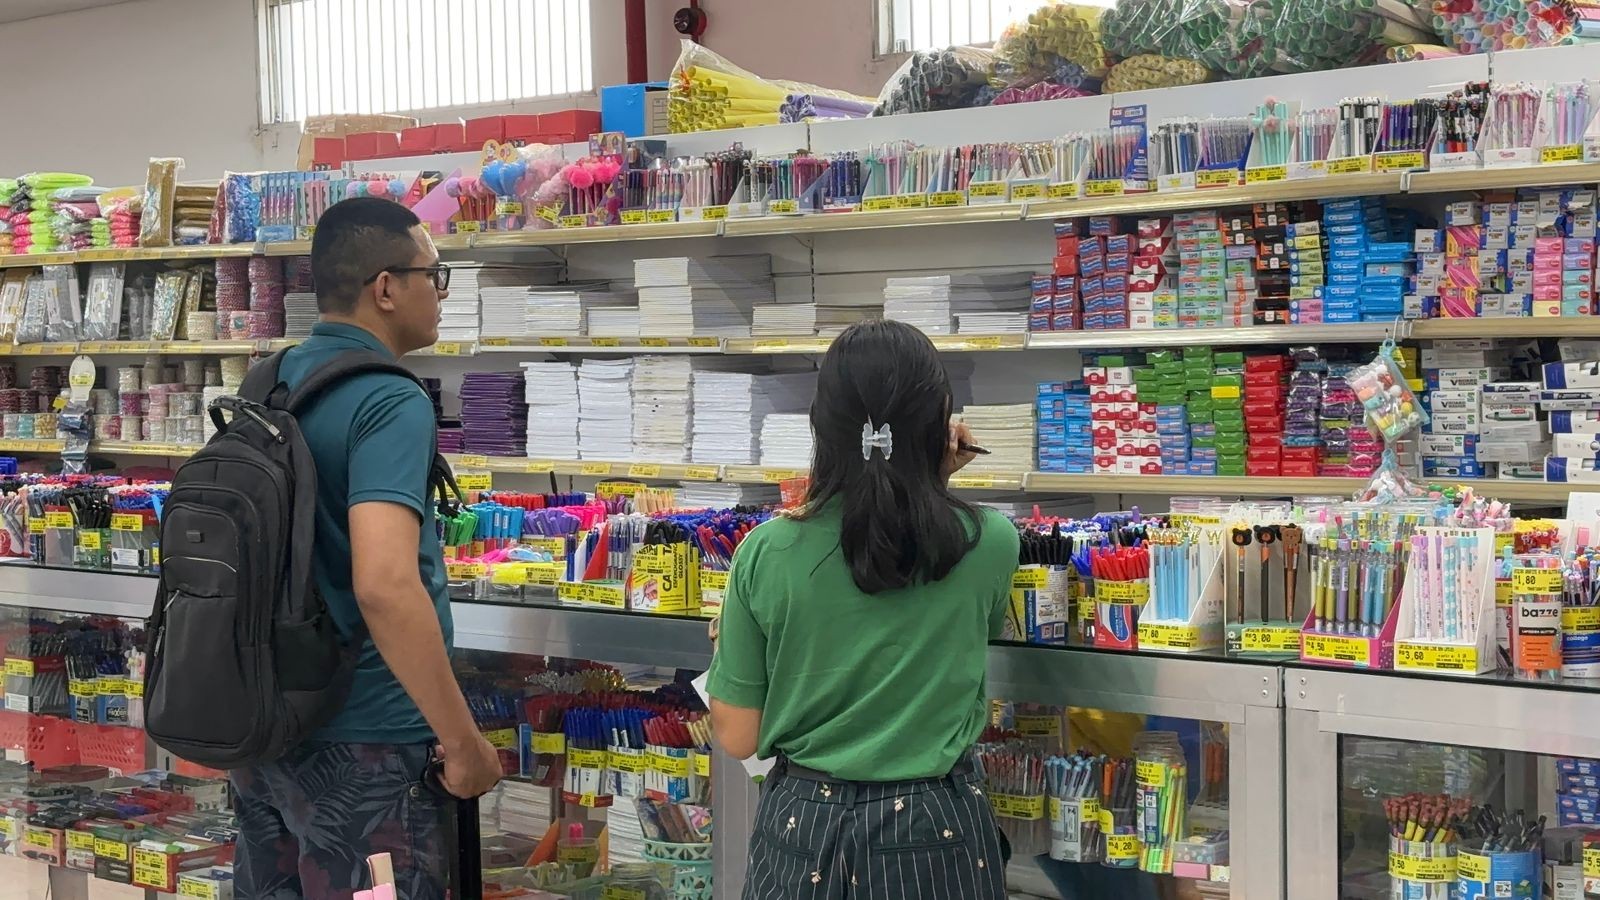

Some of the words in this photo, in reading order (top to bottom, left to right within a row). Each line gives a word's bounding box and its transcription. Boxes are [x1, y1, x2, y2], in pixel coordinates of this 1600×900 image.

[1517, 575, 1536, 586] 1,80
[1521, 607, 1559, 618] bazze
[1251, 633, 1271, 643] 3,00
[1113, 841, 1133, 852] 4,20
